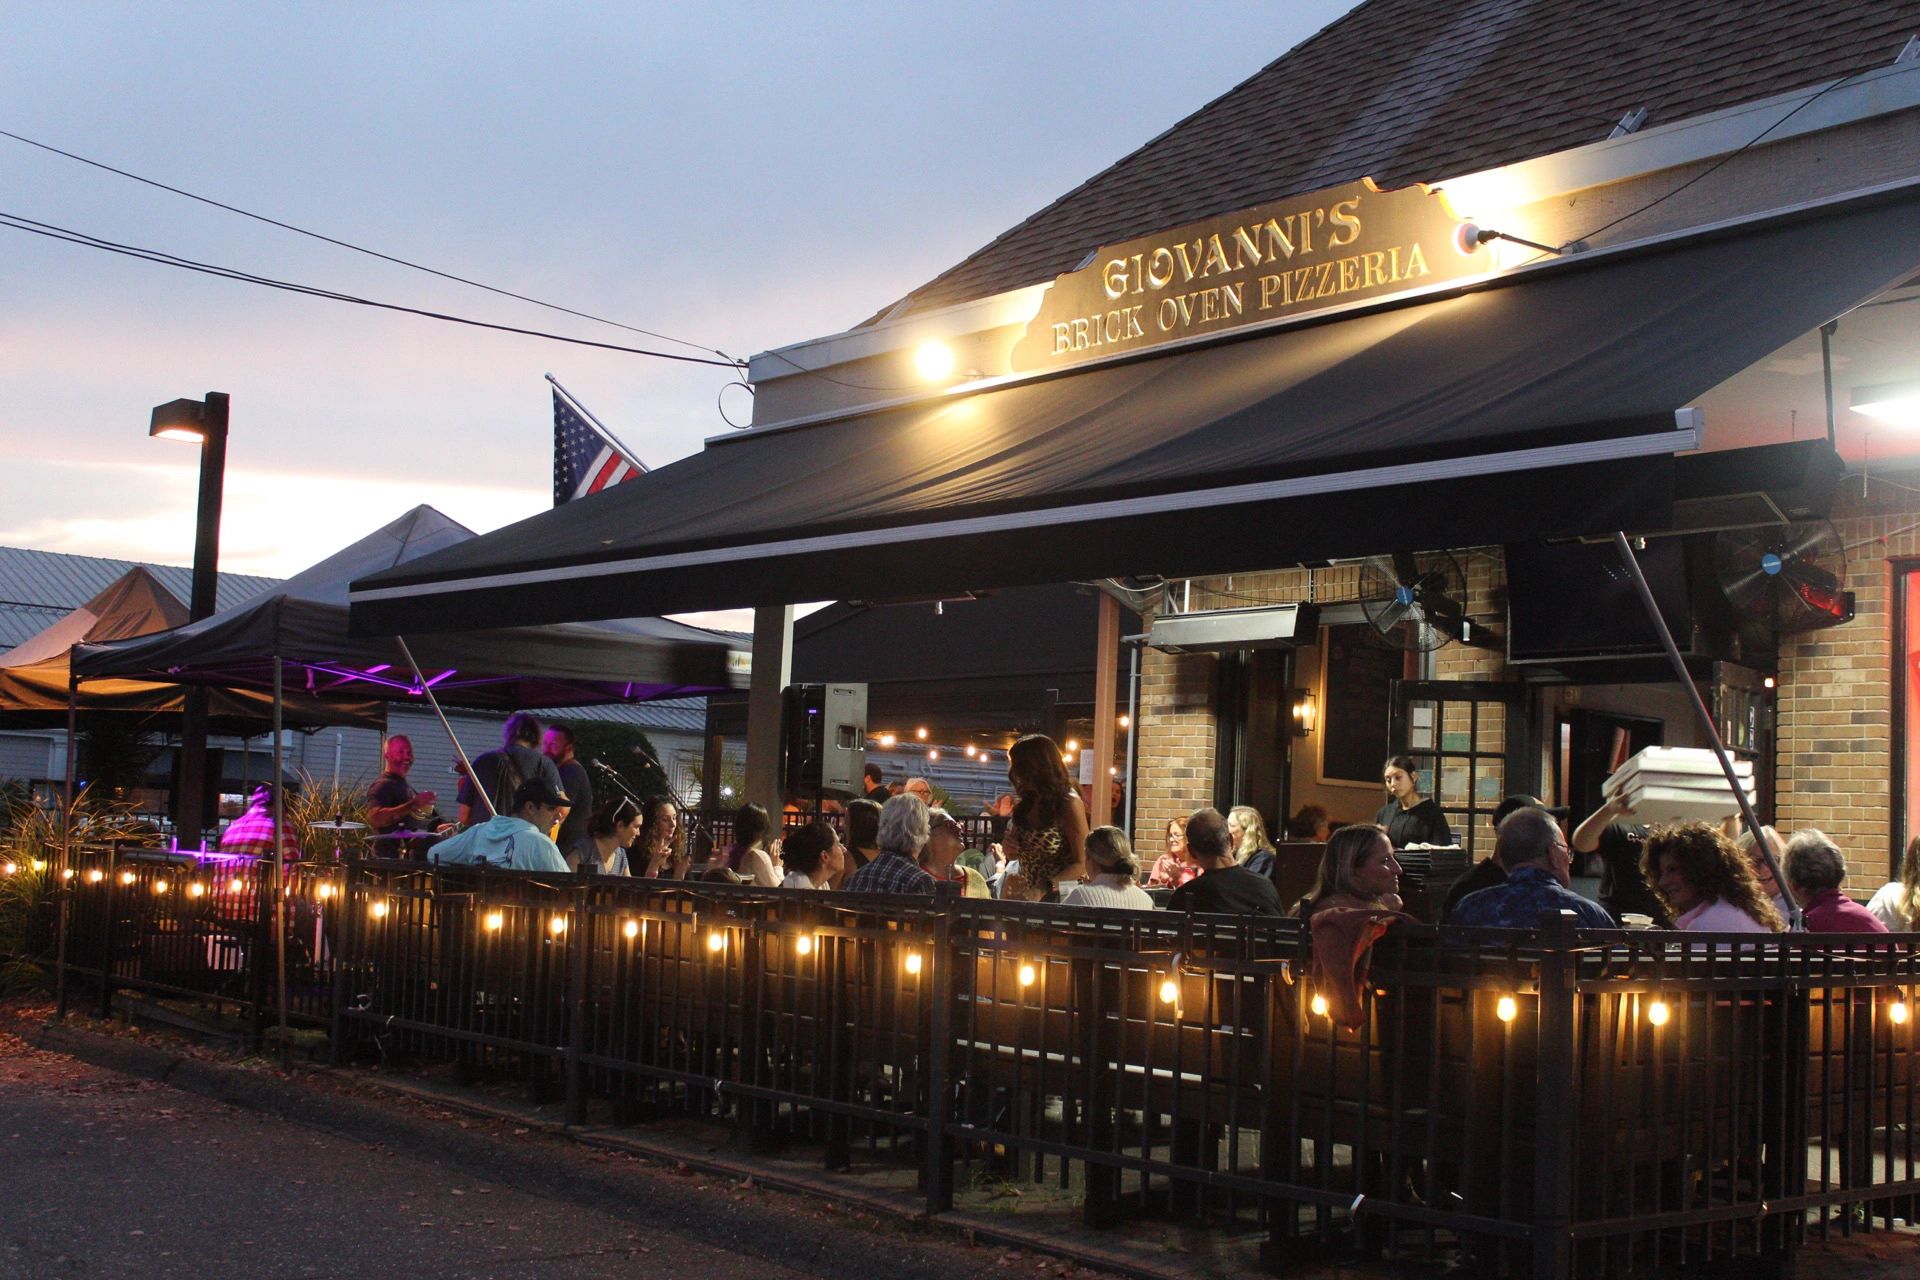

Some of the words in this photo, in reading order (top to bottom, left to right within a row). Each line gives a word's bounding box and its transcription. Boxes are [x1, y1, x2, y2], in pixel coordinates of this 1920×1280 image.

[1051, 304, 1144, 356] BRICK
[1156, 282, 1244, 332] OVEN
[1258, 242, 1432, 310] PIZZERIA
[1102, 197, 1362, 300] GIOVANNI'S
